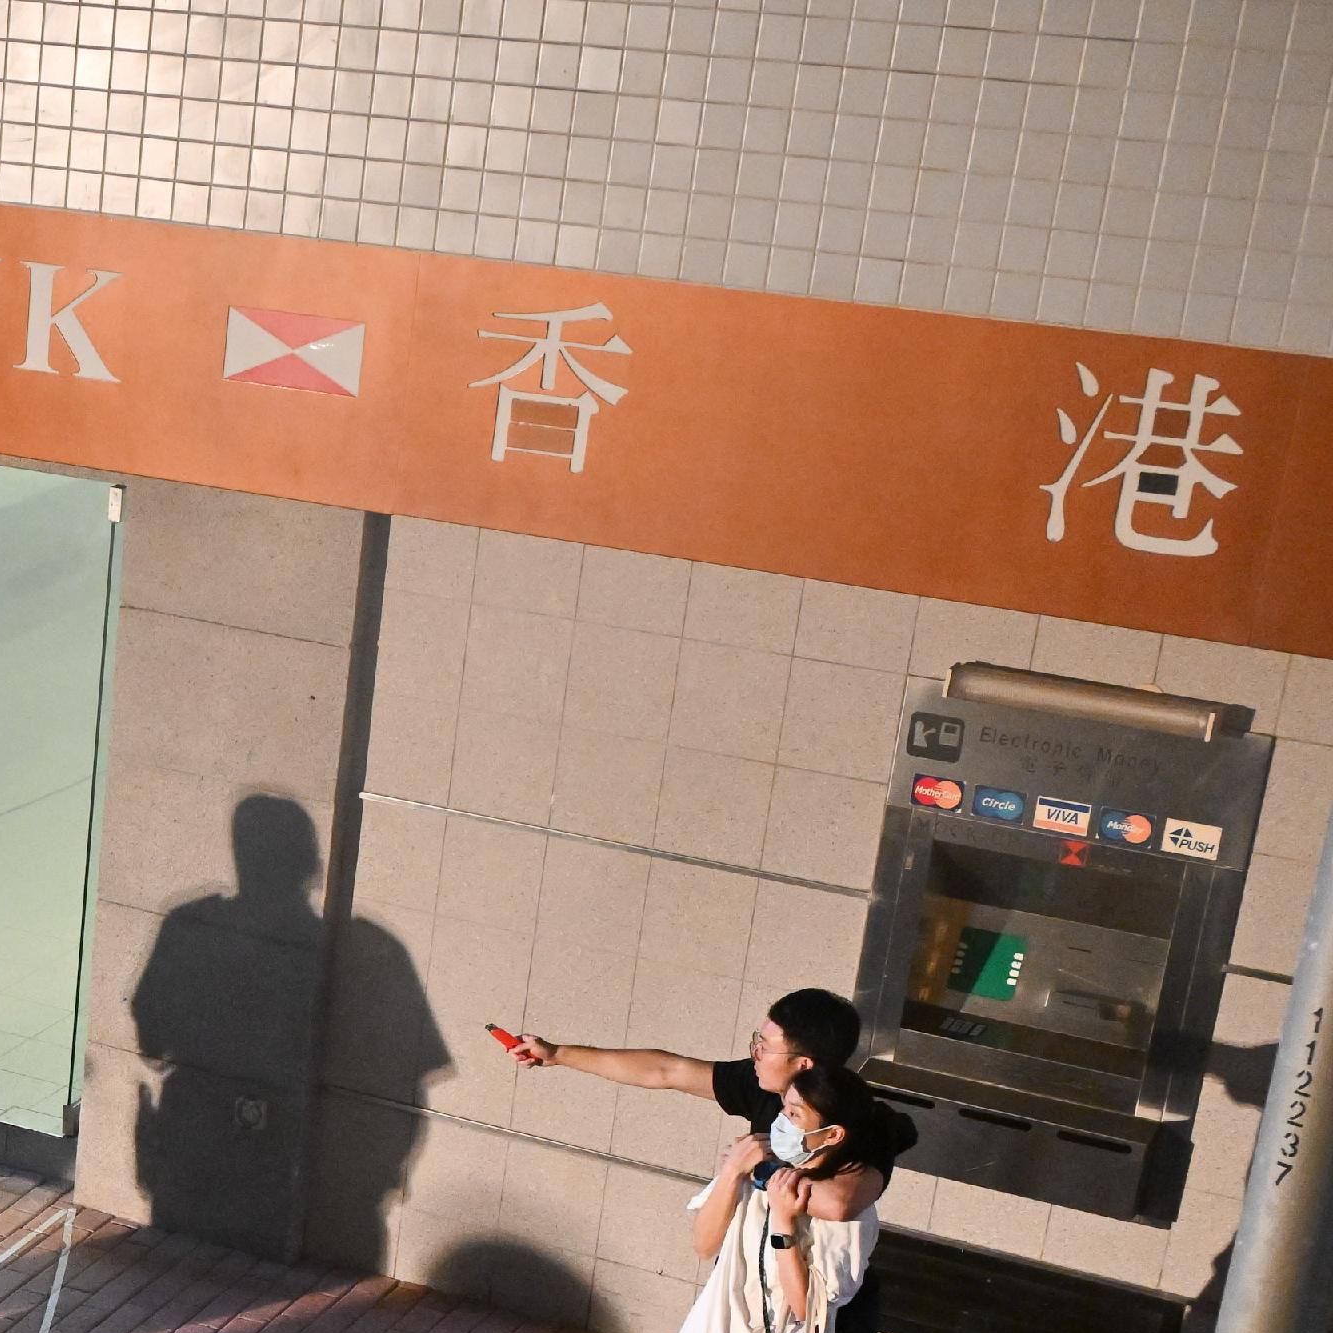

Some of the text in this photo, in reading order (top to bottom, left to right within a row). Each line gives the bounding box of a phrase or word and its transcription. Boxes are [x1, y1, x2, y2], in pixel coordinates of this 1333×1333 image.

[980, 726, 1162, 775] Electronic Money
[981, 796, 1017, 812] Circle
[1046, 807, 1081, 826] VIVA
[1178, 838, 1215, 855] PUSH
[1275, 1006, 1324, 1186] 112237
